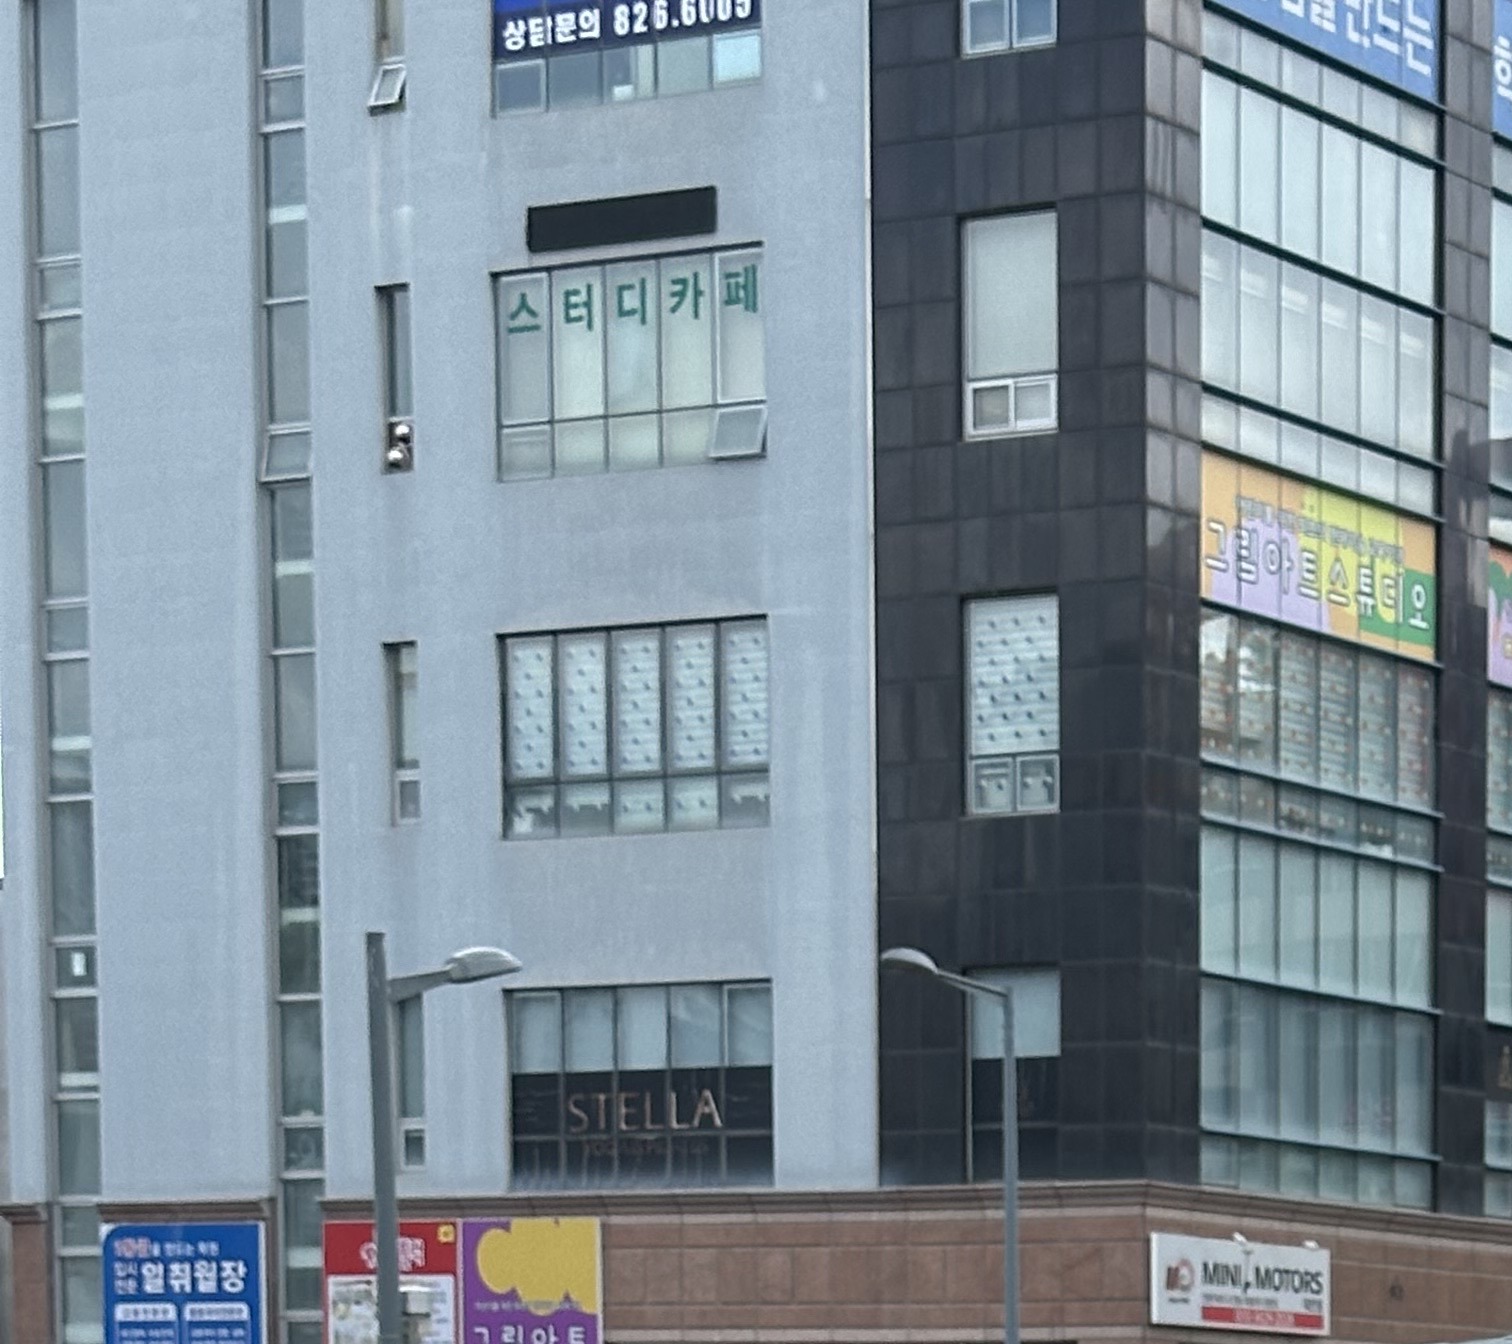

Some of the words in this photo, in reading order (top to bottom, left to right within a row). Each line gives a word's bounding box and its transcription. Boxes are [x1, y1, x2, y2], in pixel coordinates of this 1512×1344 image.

[503, 9, 600, 51] 상담문의
[507, 263, 759, 334] 스터디카페
[568, 1087, 723, 1133] STELLA
[141, 1259, 248, 1294] 일취월장
[1255, 1266, 1324, 1294] MOTORS
